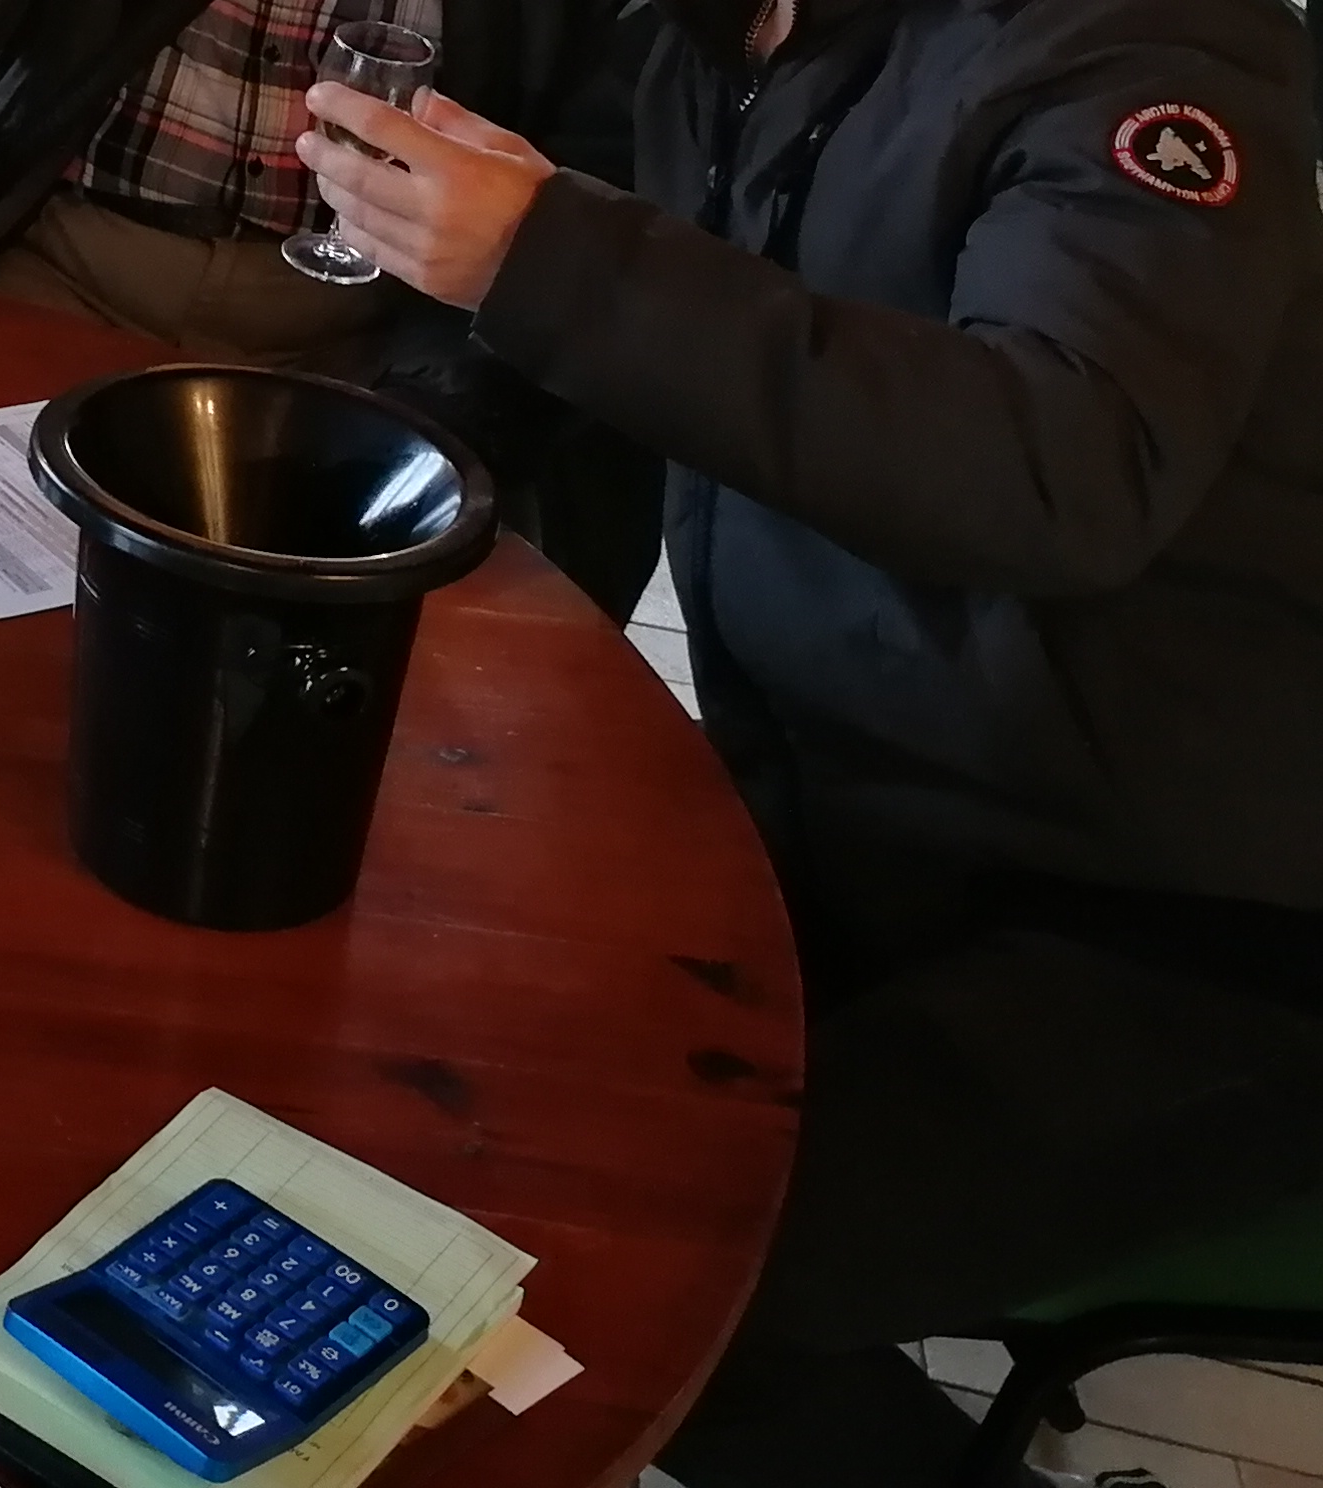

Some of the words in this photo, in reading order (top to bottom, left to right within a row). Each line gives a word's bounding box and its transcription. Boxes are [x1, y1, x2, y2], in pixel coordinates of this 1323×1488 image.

[243, 1232, 261, 1246] 3
[223, 1247, 240, 1259] 6
[202, 1264, 219, 1276] 9
[281, 1257, 299, 1271] 2
[261, 1272, 279, 1285] 5
[334, 1264, 362, 1285] 00
[240, 1288, 257, 1301] 8
[321, 1285, 335, 1298] 1
[300, 1300, 316, 1311] 4
[383, 1298, 400, 1311] 0
[278, 1318, 297, 1331] 7
[163, 1400, 222, 1446] Canon
